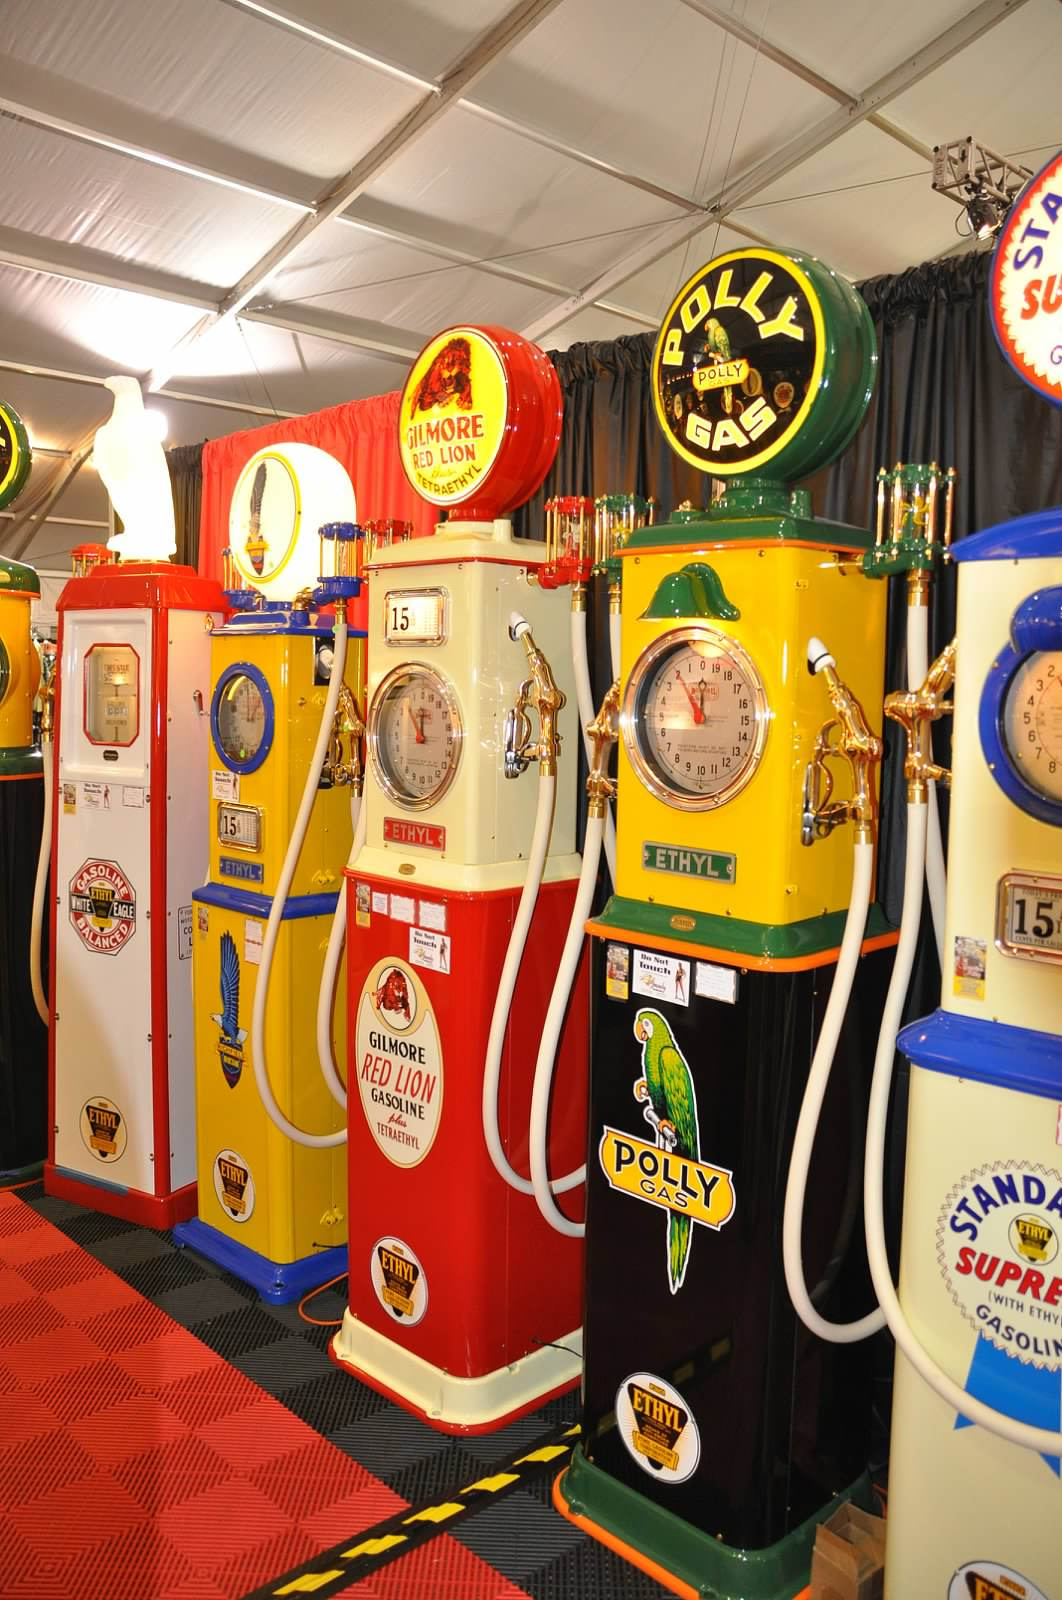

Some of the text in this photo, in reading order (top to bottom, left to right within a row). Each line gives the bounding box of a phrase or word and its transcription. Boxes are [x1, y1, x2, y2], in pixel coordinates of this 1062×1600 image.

[1013, 192, 1062, 270] STA
[662, 269, 804, 366] POLLY
[699, 363, 742, 385] POLLY
[407, 414, 484, 450] GILMORE
[686, 396, 777, 451] GAS
[412, 443, 476, 470] RED LION
[416, 464, 482, 495] TETRAETHYL
[392, 607, 409, 631] 15
[711, 663, 721, 673] 19
[723, 671, 733, 681] 18
[1047, 665, 1056, 678] 2
[666, 681, 672, 692] 3
[733, 684, 742, 694] 17
[1036, 679, 1044, 692] 3
[661, 696, 666, 706] 4
[738, 699, 748, 709] 16
[1027, 695, 1035, 706] 4
[659, 712, 665, 722] 5
[740, 715, 750, 726] 15
[1023, 712, 1031, 725] 5
[660, 728, 666, 738] 6
[738, 732, 748, 742] 14
[1028, 730, 1036, 742] 6
[666, 743, 672, 753] 7
[731, 747, 741, 757] 13
[1035, 747, 1042, 760] 7
[674, 754, 680, 764] 8
[685, 761, 691, 772] 9
[721, 757, 731, 767] 12
[1048, 761, 1056, 774] 8
[697, 765, 706, 776] 10
[710, 764, 718, 775] 11
[224, 815, 237, 836] 15
[392, 823, 435, 845] ETHYL
[224, 861, 256, 879] ETHYL
[655, 848, 719, 878] ETHYL
[77, 865, 128, 897] GASOLINE
[91, 887, 113, 902] ETHYL
[71, 895, 134, 919] WHITE EAGLE
[1014, 899, 1054, 938] 15
[77, 917, 128, 949] BALANCED
[641, 953, 669, 966] Do Not
[369, 1031, 426, 1065] GILMORE
[361, 1053, 436, 1104] RED LION
[371, 1087, 425, 1120] GASOLINE
[89, 1108, 118, 1129] ETHYL
[387, 1112, 407, 1128] plus
[377, 1122, 420, 1151] TETRAETHYL
[221, 1161, 247, 1186] ETHYL
[613, 1139, 720, 1209] POLLY
[640, 1179, 688, 1208] GAS
[1018, 1221, 1050, 1241] ETHYL
[382, 1249, 417, 1284] ETHYL
[955, 1247, 1062, 1307] SUPRE
[988, 1291, 1024, 1313] (WITH
[633, 1388, 682, 1432] ETHYL
